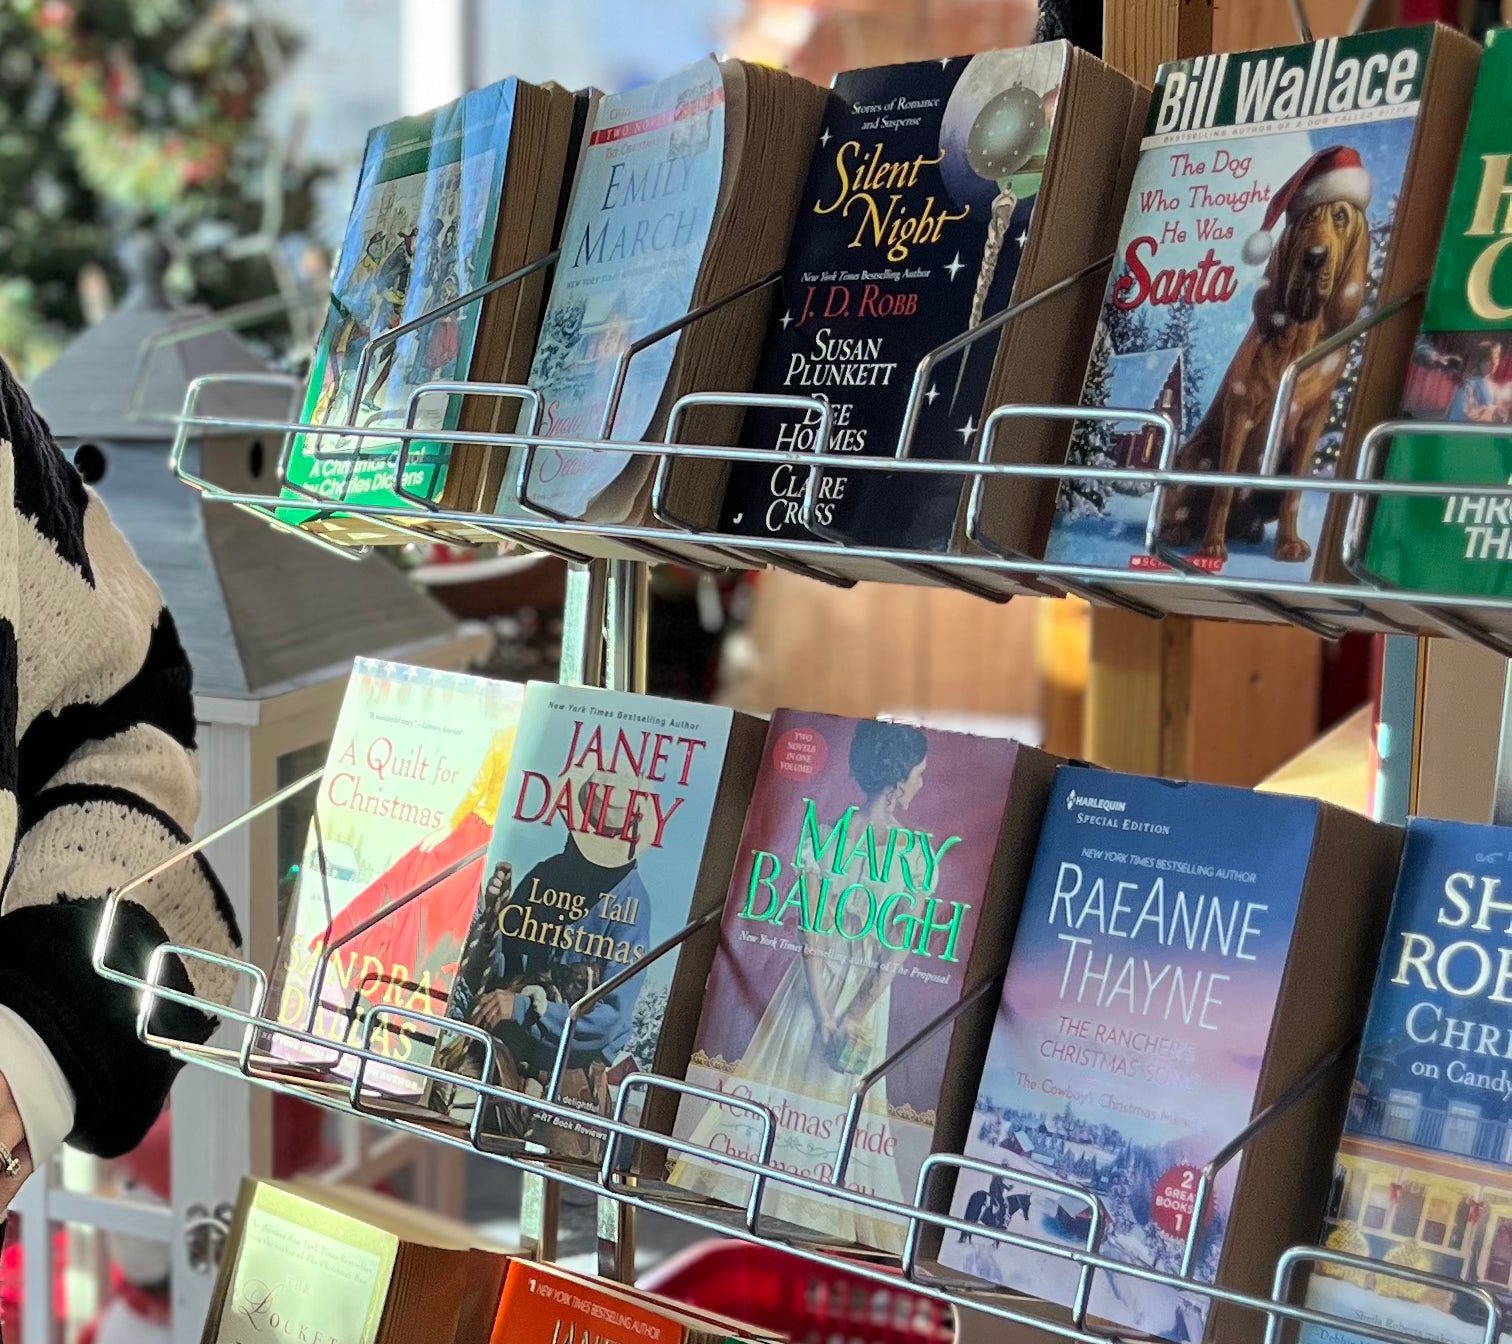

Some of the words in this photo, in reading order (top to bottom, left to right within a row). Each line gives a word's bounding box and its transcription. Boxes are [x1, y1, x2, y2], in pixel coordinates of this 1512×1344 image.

[1155, 53, 1229, 135] Bill
[1235, 36, 1418, 125] Wallace
[851, 101, 882, 115] Stories
[883, 99, 897, 112] of
[897, 97, 940, 110] Romance
[861, 118, 879, 130] and
[881, 116, 921, 131] Suspense
[1163, 129, 1227, 143] BESTSELLING
[1232, 124, 1272, 137] AUTHOR
[1307, 117, 1329, 127] DOG
[1334, 111, 1373, 124] CALLED
[814, 141, 945, 214] Silent
[1170, 153, 1206, 177] The
[1211, 150, 1253, 179] Dog
[600, 157, 695, 212] EMILY
[1140, 189, 1180, 214] Who
[1188, 179, 1271, 213] Thought
[571, 207, 700, 269] MARCH
[843, 193, 970, 262] Night
[1160, 221, 1187, 245] He
[1196, 218, 1234, 241] Was
[801, 272, 820, 283] New
[820, 271, 838, 282] York
[839, 270, 860, 281] Times
[861, 269, 901, 282] Bestselling
[902, 267, 931, 278] Author
[1112, 235, 1238, 311] Santa
[796, 286, 816, 327] J.
[823, 285, 850, 318] D.
[858, 284, 918, 318] ROBB
[811, 328, 883, 362] SUSAN
[784, 353, 896, 386] PLUNKETT
[568, 704, 586, 714] York
[590, 707, 613, 718] Times
[617, 711, 666, 727] Bestselling
[669, 718, 700, 731] Author
[338, 739, 356, 765] A
[367, 737, 429, 780] Quilt
[432, 756, 459, 785] for
[558, 720, 707, 786] JANET
[328, 772, 443, 829] Christmas
[512, 769, 685, 848] DAILEY
[1076, 796, 1126, 812] HARLEQUIN
[1076, 812, 1118, 828] SPECIAL
[1122, 819, 1171, 835] EDITION
[790, 797, 962, 895] MARY
[1081, 848, 1103, 859] NEW
[1104, 851, 1129, 864] YORK
[1130, 855, 1155, 868] TIMES
[1155, 859, 1214, 877] BESTSELLING
[1215, 867, 1257, 883] AUTHOR
[528, 877, 589, 921] Long,
[598, 892, 640, 925] Tall
[737, 849, 972, 963] BALOGH
[498, 904, 646, 964] Christmas
[284, 934, 432, 1015] SANDRA
[738, 930, 758, 943] New
[759, 933, 779, 949] York
[779, 938, 804, 952] Times
[880, 959, 891, 973] of
[891, 961, 909, 976] The
[909, 966, 951, 985] Proposal
[1057, 933, 1231, 1031] THAYNE
[1058, 1015, 1091, 1039] THE
[1040, 1039, 1139, 1078] CHRISTMAS
[1411, 1061, 1438, 1079] on
[1016, 1071, 1037, 1090] The
[1164, 1187, 1194, 1203] GREA
[1181, 1170, 1194, 1189] 2
[1156, 1196, 1194, 1215] BOOKS
[537, 1283, 554, 1302] NEW
[554, 1288, 571, 1306] YORK
[572, 1296, 591, 1313] TIMES
[591, 1304, 633, 1330] BESTSELLING
[633, 1321, 661, 1341] AUTHOR
